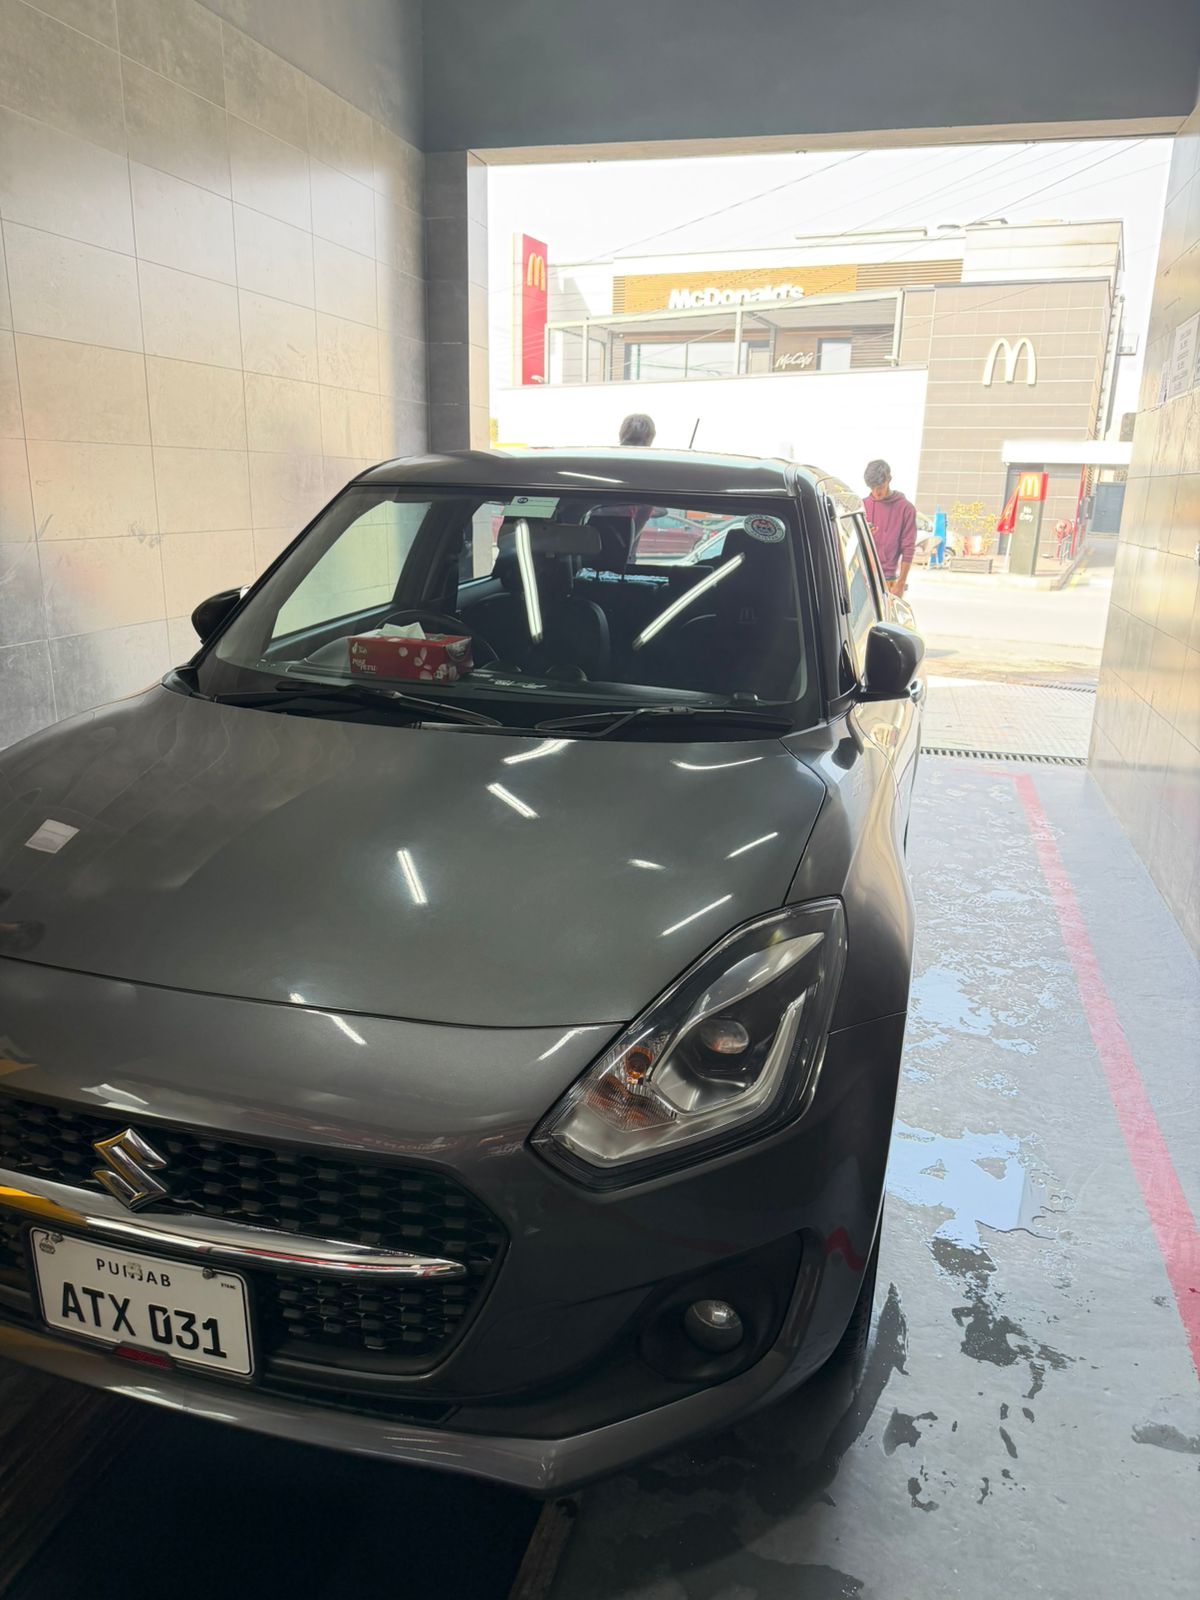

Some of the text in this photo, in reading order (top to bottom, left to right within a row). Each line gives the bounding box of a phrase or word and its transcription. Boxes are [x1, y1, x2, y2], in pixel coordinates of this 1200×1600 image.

[668, 283, 804, 310] McDonald's
[96, 1258, 171, 1288] PUNJAB
[62, 1282, 227, 1359] ATX 031
